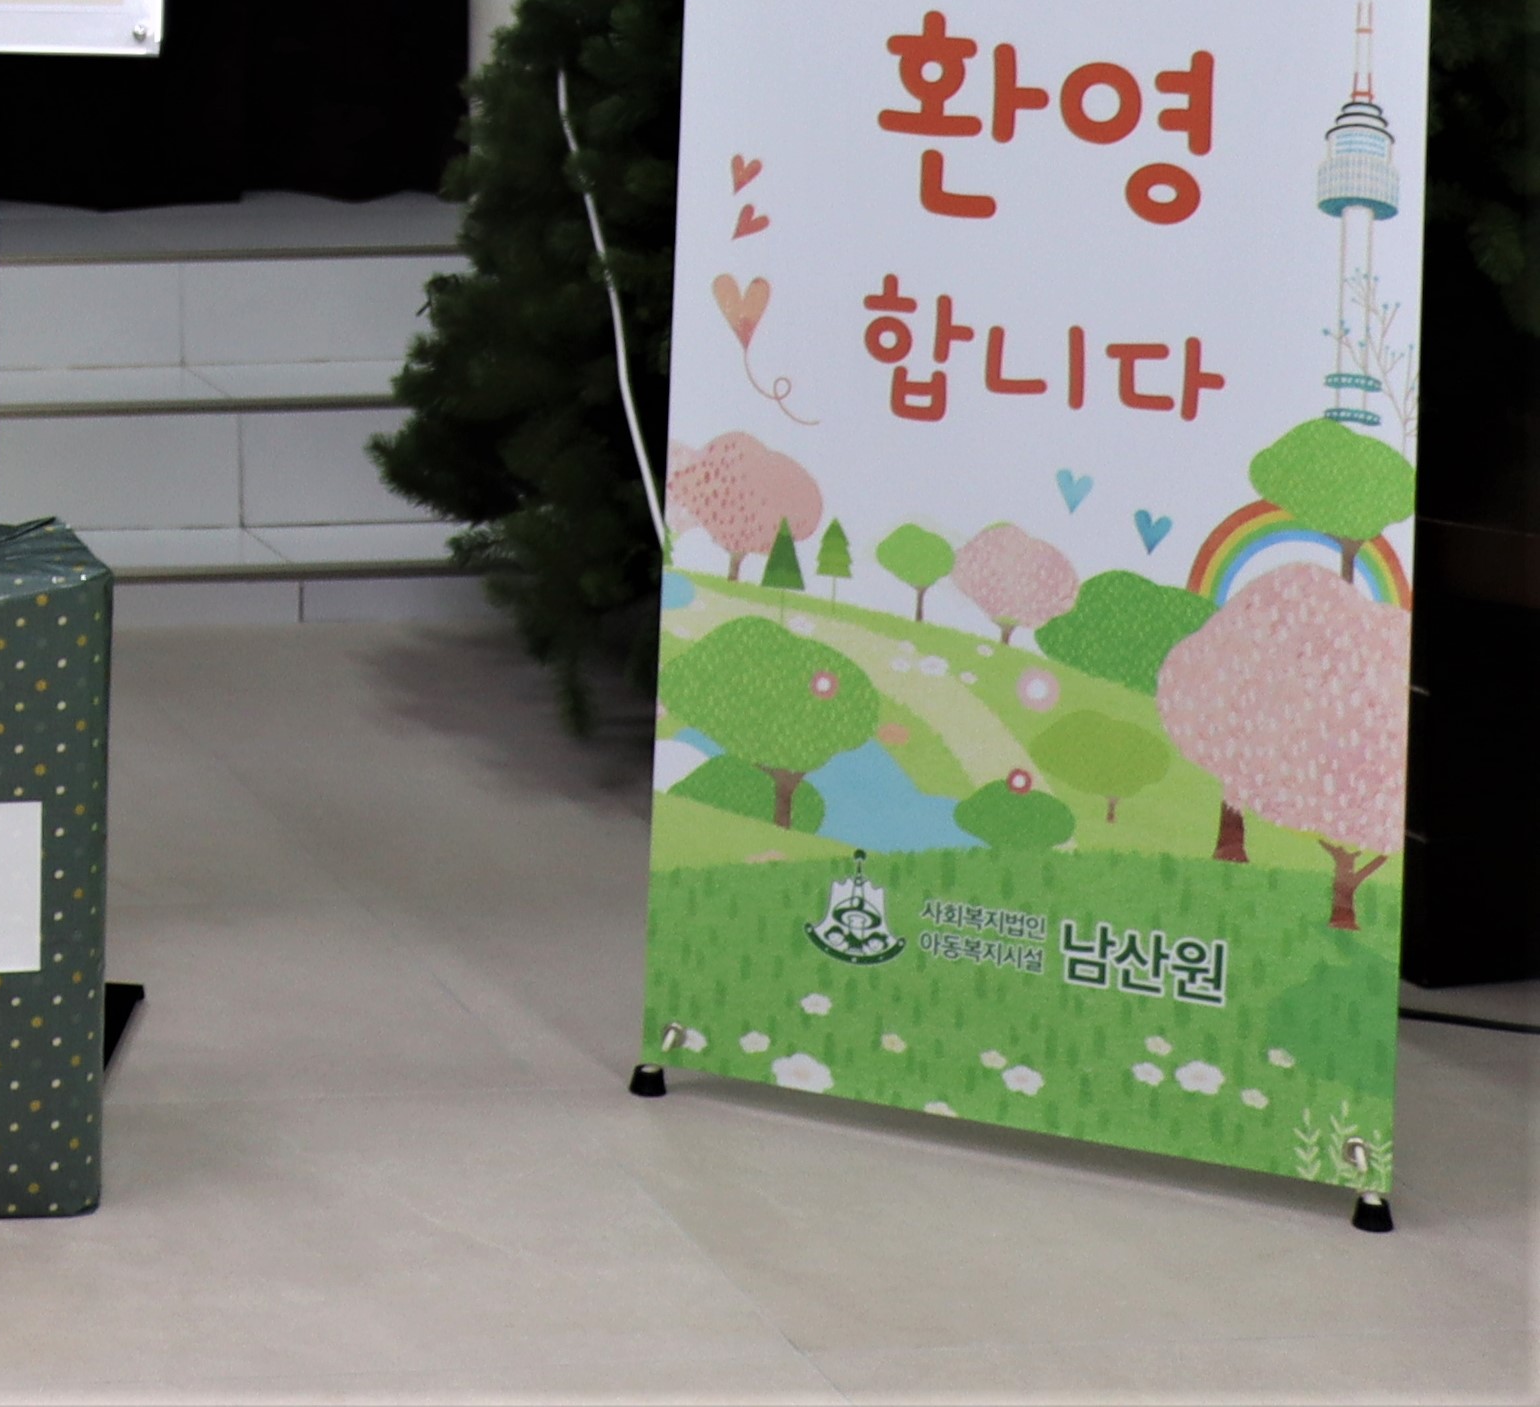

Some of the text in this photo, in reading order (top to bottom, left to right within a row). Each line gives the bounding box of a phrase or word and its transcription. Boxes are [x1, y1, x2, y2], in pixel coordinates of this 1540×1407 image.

[877, 10, 1214, 225] 환영
[863, 273, 1225, 423] 합니다
[920, 931, 1044, 973] 아동복지시설
[921, 901, 1046, 940] 사회복지법인
[1062, 922, 1226, 1005] 남산원
